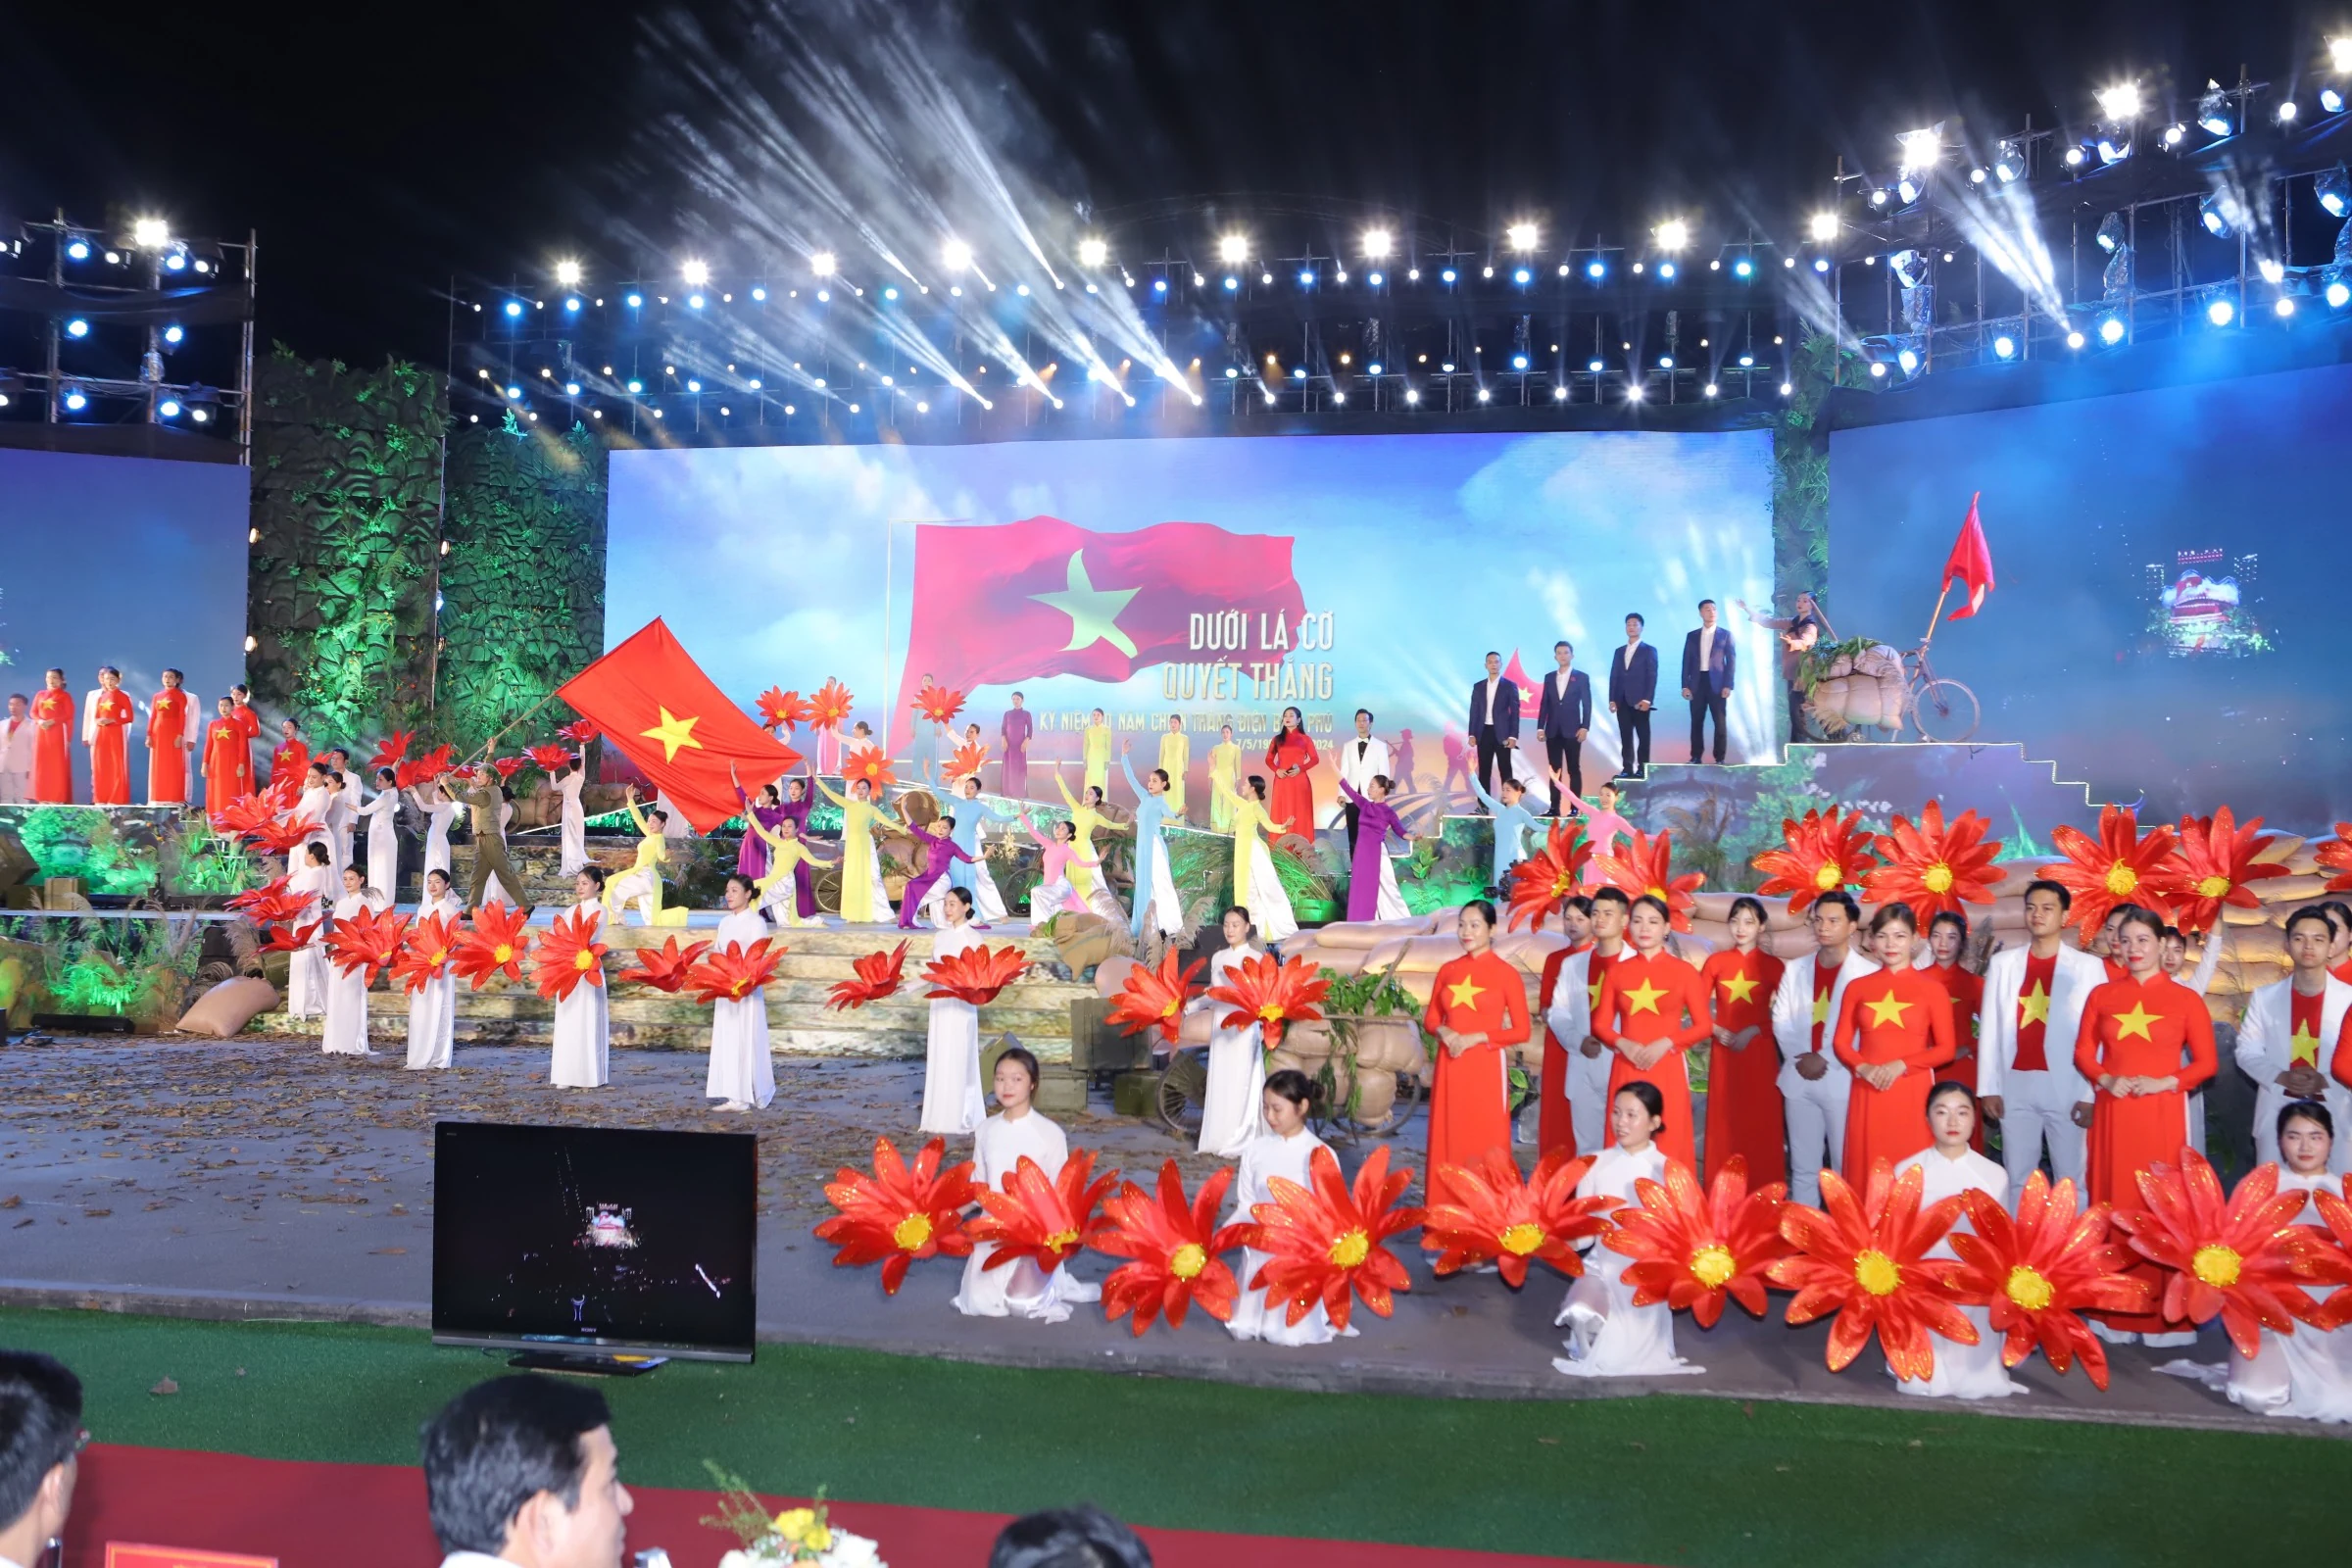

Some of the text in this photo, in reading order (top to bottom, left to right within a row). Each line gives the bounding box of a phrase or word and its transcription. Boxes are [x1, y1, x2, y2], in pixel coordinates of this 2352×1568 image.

[1190, 608, 1335, 651] DƯỚI LÁ CỜ
[1162, 655, 1334, 701] QUYẾT THẮNG
